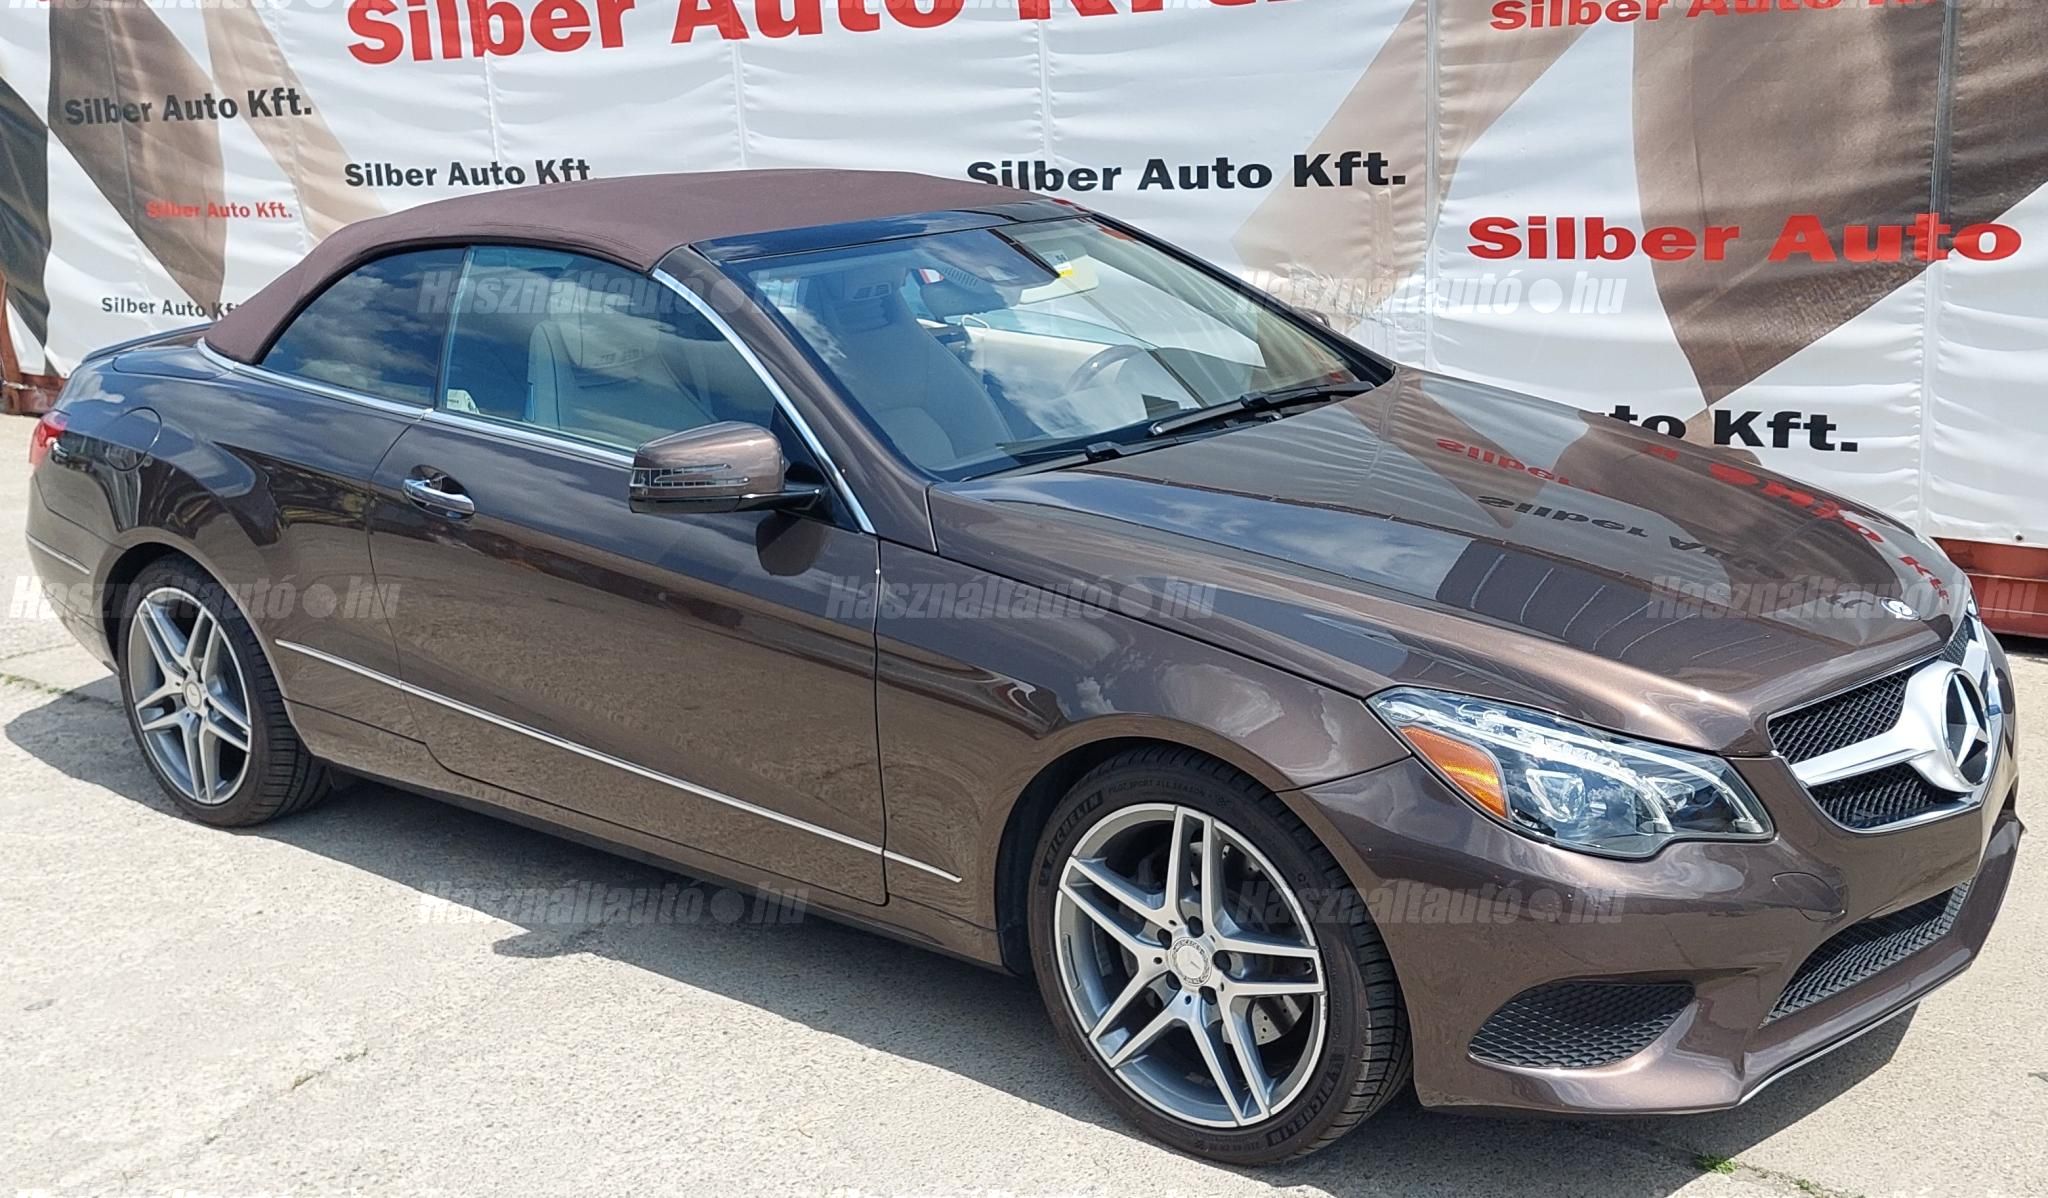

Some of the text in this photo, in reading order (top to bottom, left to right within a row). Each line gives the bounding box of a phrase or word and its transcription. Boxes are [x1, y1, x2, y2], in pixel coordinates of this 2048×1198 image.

[347, 0, 636, 64] Silber
[1489, 0, 1670, 31] Silber
[64, 87, 312, 125] Silber Auto Kft.
[344, 158, 591, 187] Silber Auto Kft
[967, 151, 1407, 192] Silber Auto Kft.
[145, 201, 293, 218] Silber Auto Kft.
[1467, 213, 2022, 262] Silber Auto
[101, 297, 241, 319] Silber Auto Kf
[1714, 409, 1858, 452] Kft.
[1045, 791, 1102, 865] MICHELIN
[1269, 1072, 1337, 1145] MICHELIN
